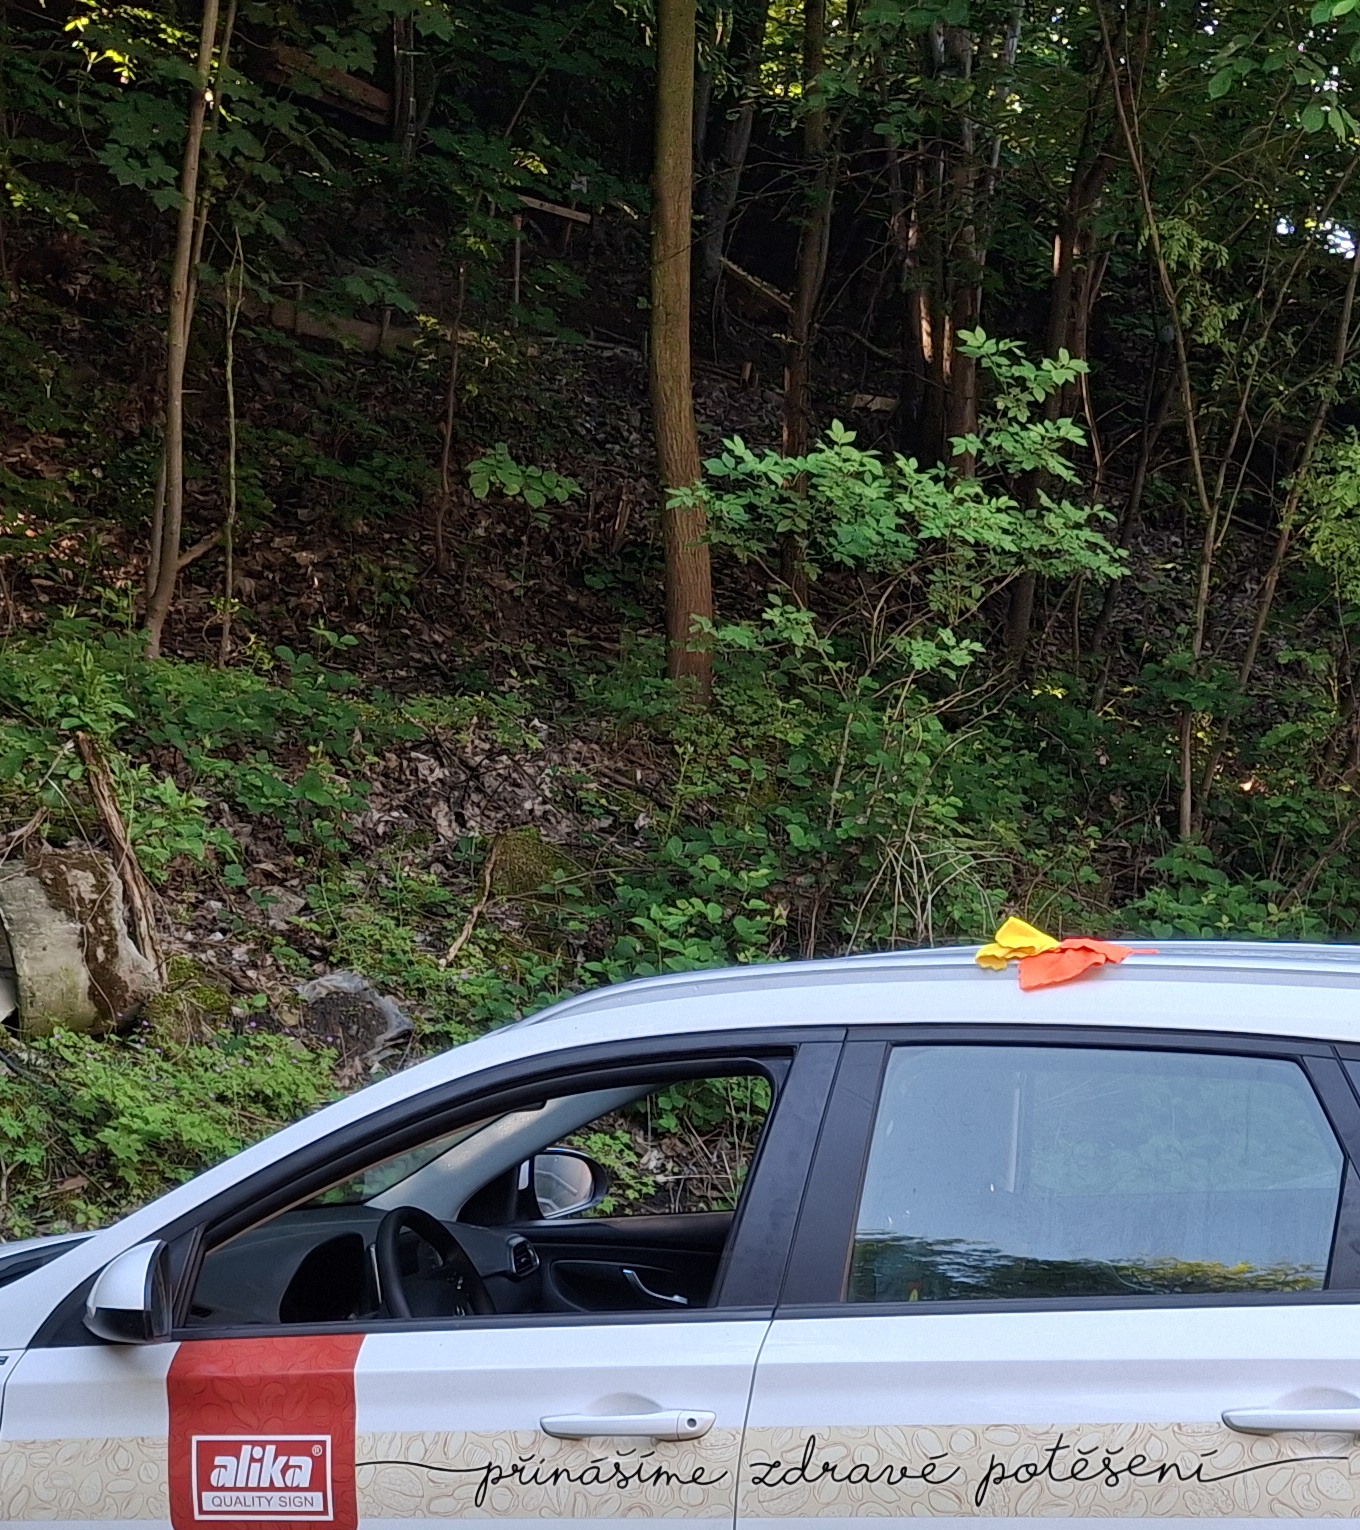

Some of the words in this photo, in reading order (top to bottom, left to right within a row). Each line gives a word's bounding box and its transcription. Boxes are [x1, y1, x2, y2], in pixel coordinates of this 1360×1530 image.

[210, 1444, 313, 1488] alika
[474, 1448, 728, 1508] přinášíme
[739, 1434, 961, 1488] zdravé
[974, 1433, 1219, 1507] potěšení
[211, 1495, 273, 1508] QUALITY
[278, 1495, 314, 1508] SIGN
